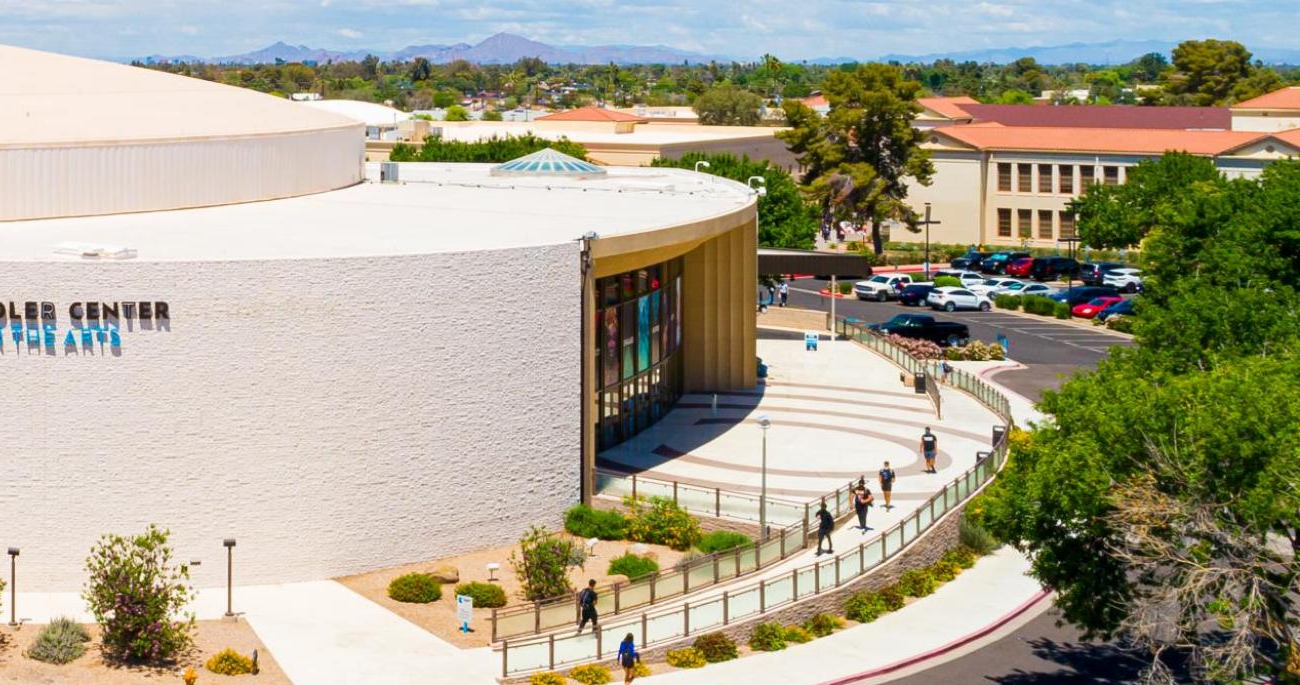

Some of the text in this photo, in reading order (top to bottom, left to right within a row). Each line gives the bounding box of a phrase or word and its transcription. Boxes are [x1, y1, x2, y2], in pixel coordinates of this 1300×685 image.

[68, 300, 171, 320] CENTER
[10, 323, 56, 347] THE
[63, 323, 121, 347] ARTS
